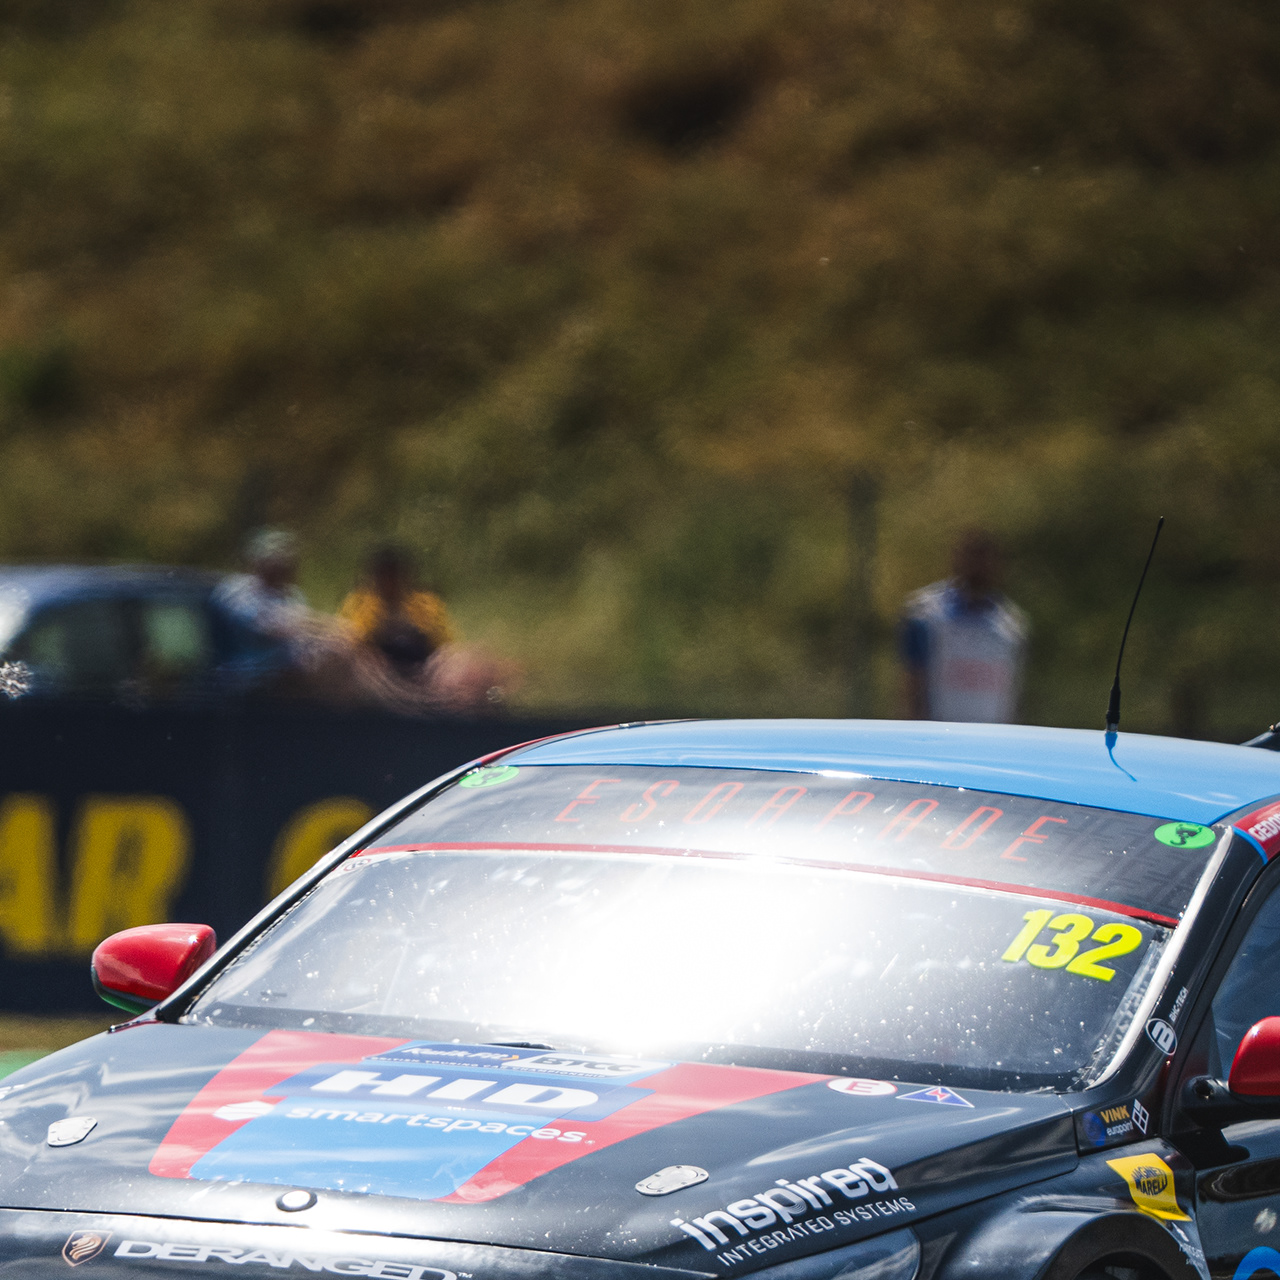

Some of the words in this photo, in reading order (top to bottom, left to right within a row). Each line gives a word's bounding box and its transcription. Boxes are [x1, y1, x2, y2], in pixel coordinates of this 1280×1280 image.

[1001, 908, 1142, 982] 132
[530, 1056, 641, 1073] BTCC
[310, 1069, 600, 1109] HID
[286, 1106, 588, 1142] smartspaces
[1100, 1105, 1130, 1124] VINK
[670, 1158, 900, 1251] inspired
[717, 1214, 835, 1268] INTEGRATED
[838, 1197, 916, 1226] SYSTEMS
